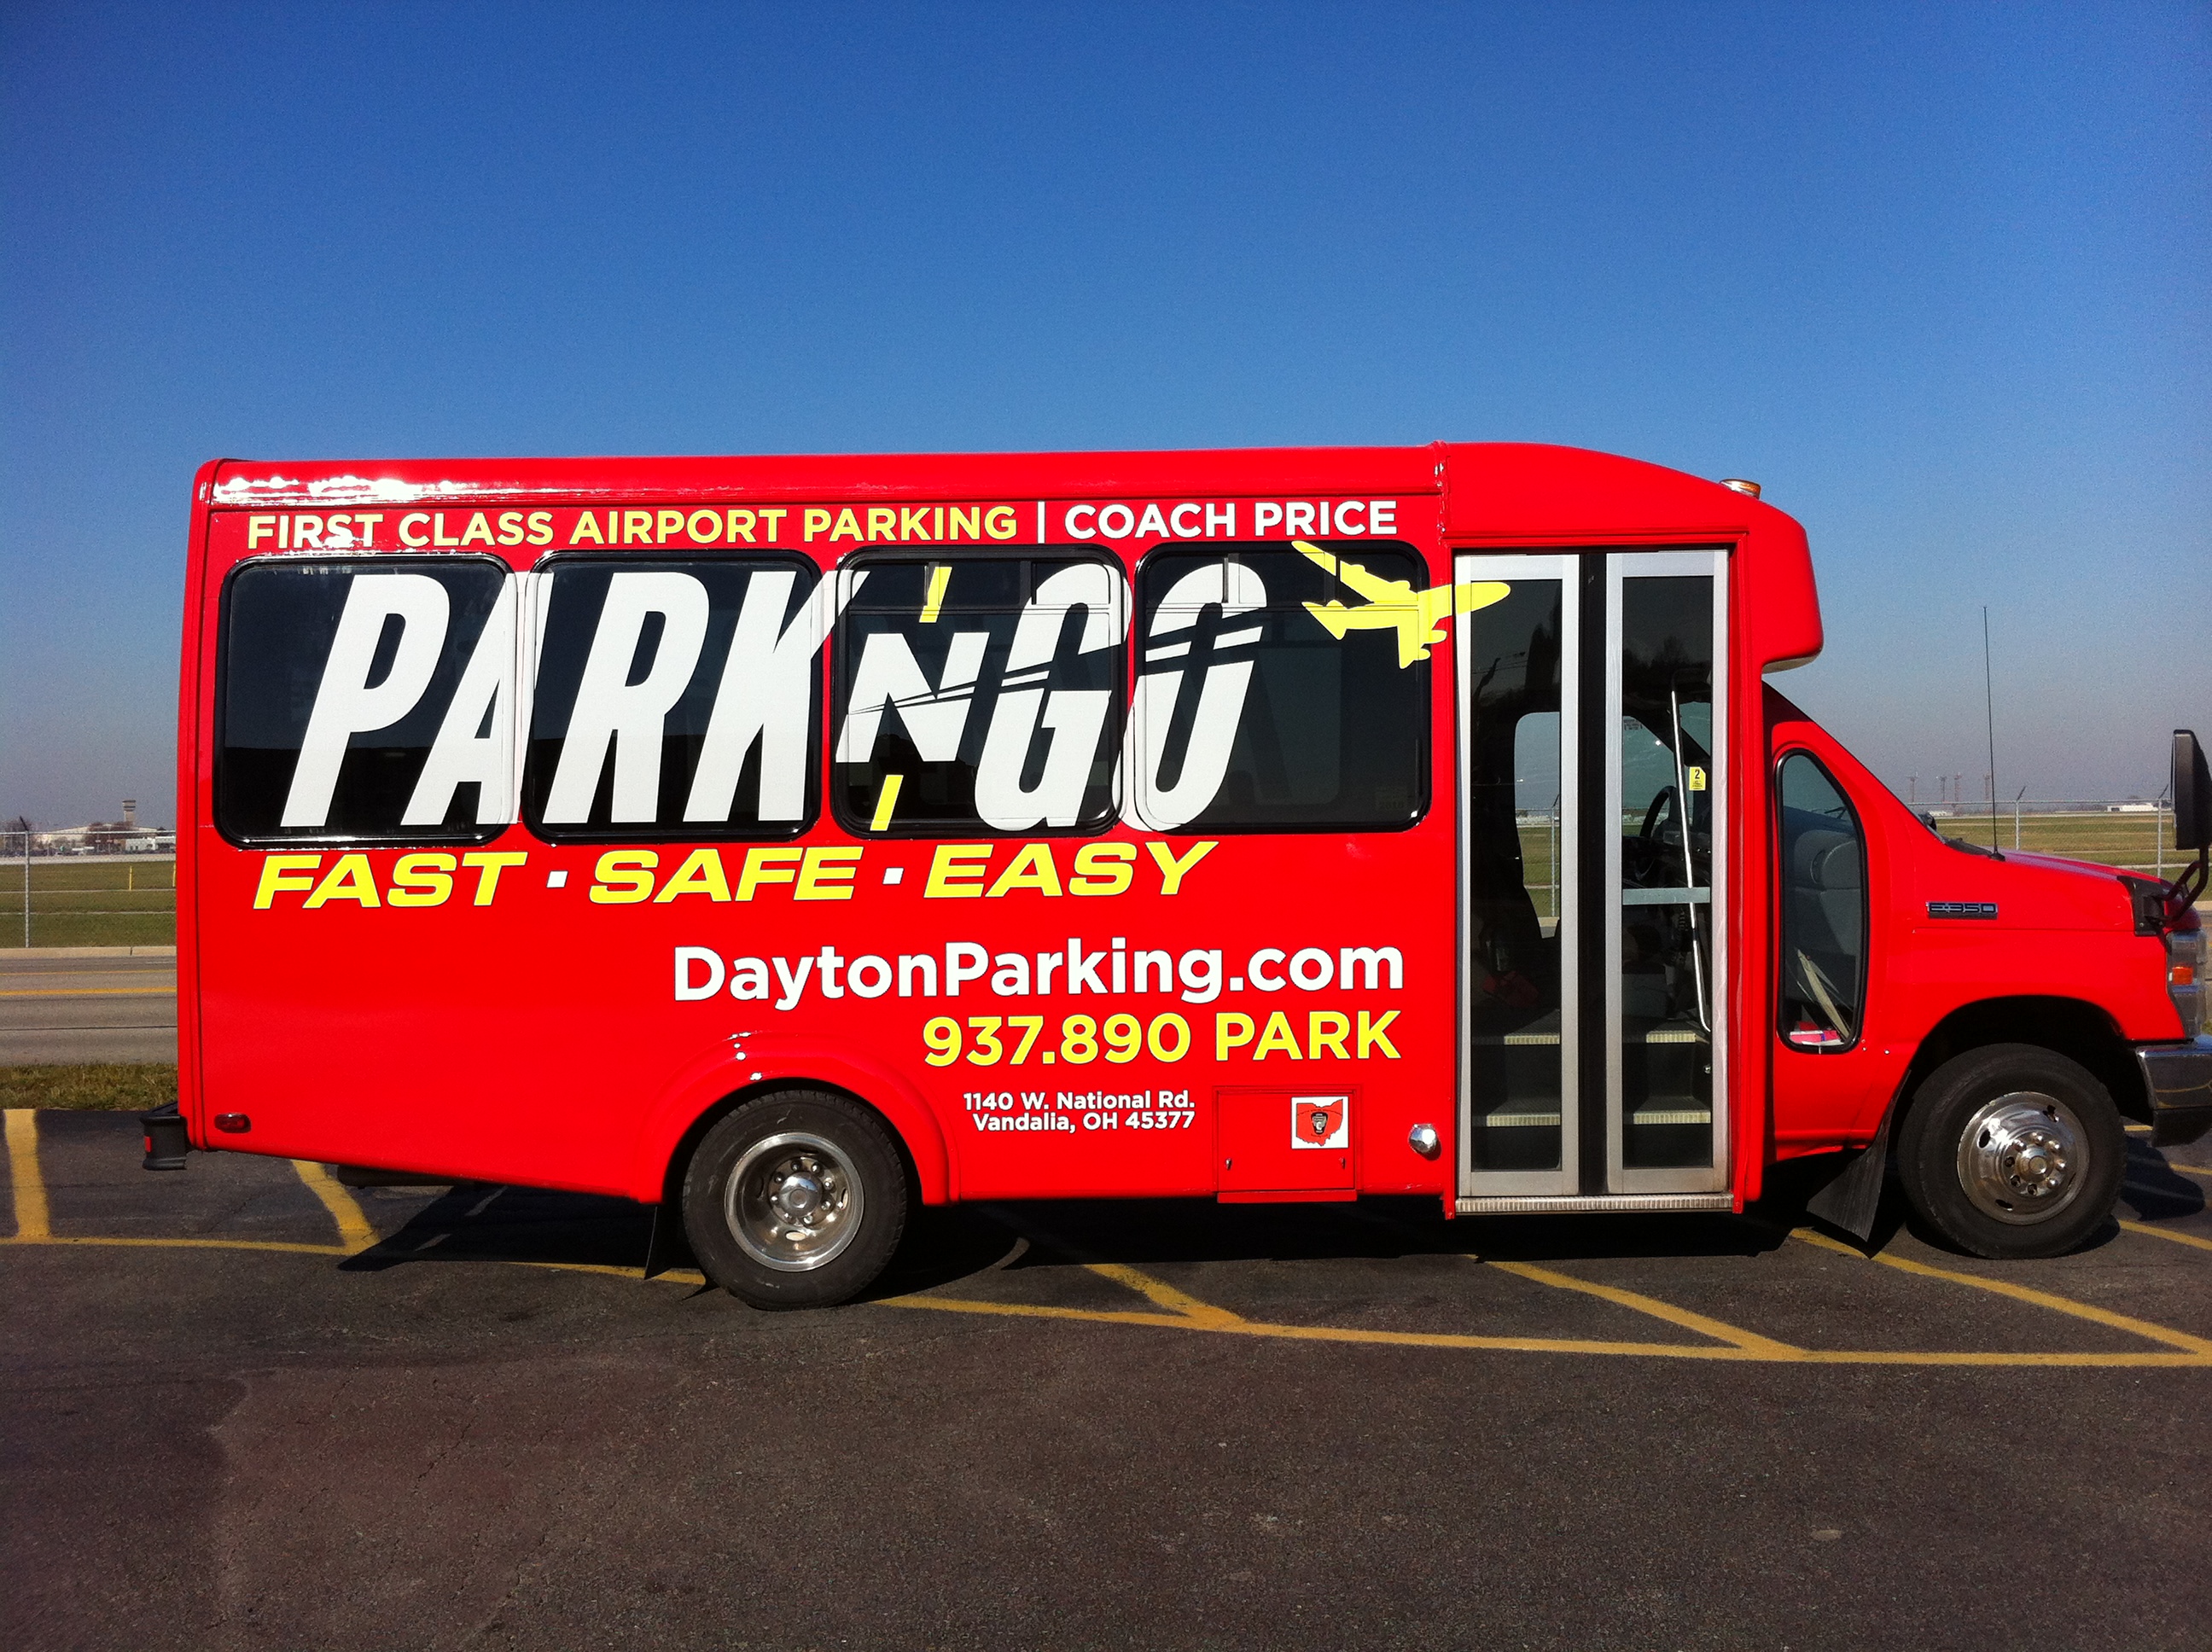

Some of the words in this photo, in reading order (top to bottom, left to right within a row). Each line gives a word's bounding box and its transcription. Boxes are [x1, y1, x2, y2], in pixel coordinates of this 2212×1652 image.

[248, 514, 384, 549] FIRST
[399, 512, 555, 547] CLASS
[569, 509, 788, 545] AIRPORT
[803, 505, 1017, 543] PARKING
[1064, 503, 1237, 540] COACH
[1254, 500, 1398, 537] PRICE
[253, 846, 528, 910] FAST
[589, 846, 864, 905] SAFE
[923, 841, 1220, 899] EASY
[673, 937, 1405, 1013] DaytonParking.com
[923, 1012, 1192, 1067] 937.890
[1214, 1010, 1402, 1062] PARK
[963, 1091, 1014, 1111] 1140
[1020, 1091, 1050, 1110] W.
[1057, 1090, 1151, 1110] National
[1158, 1090, 1196, 1108] Rd.
[972, 1111, 1076, 1134] Vandalia,
[1082, 1111, 1119, 1131] OH
[1125, 1110, 1196, 1130] 45377
